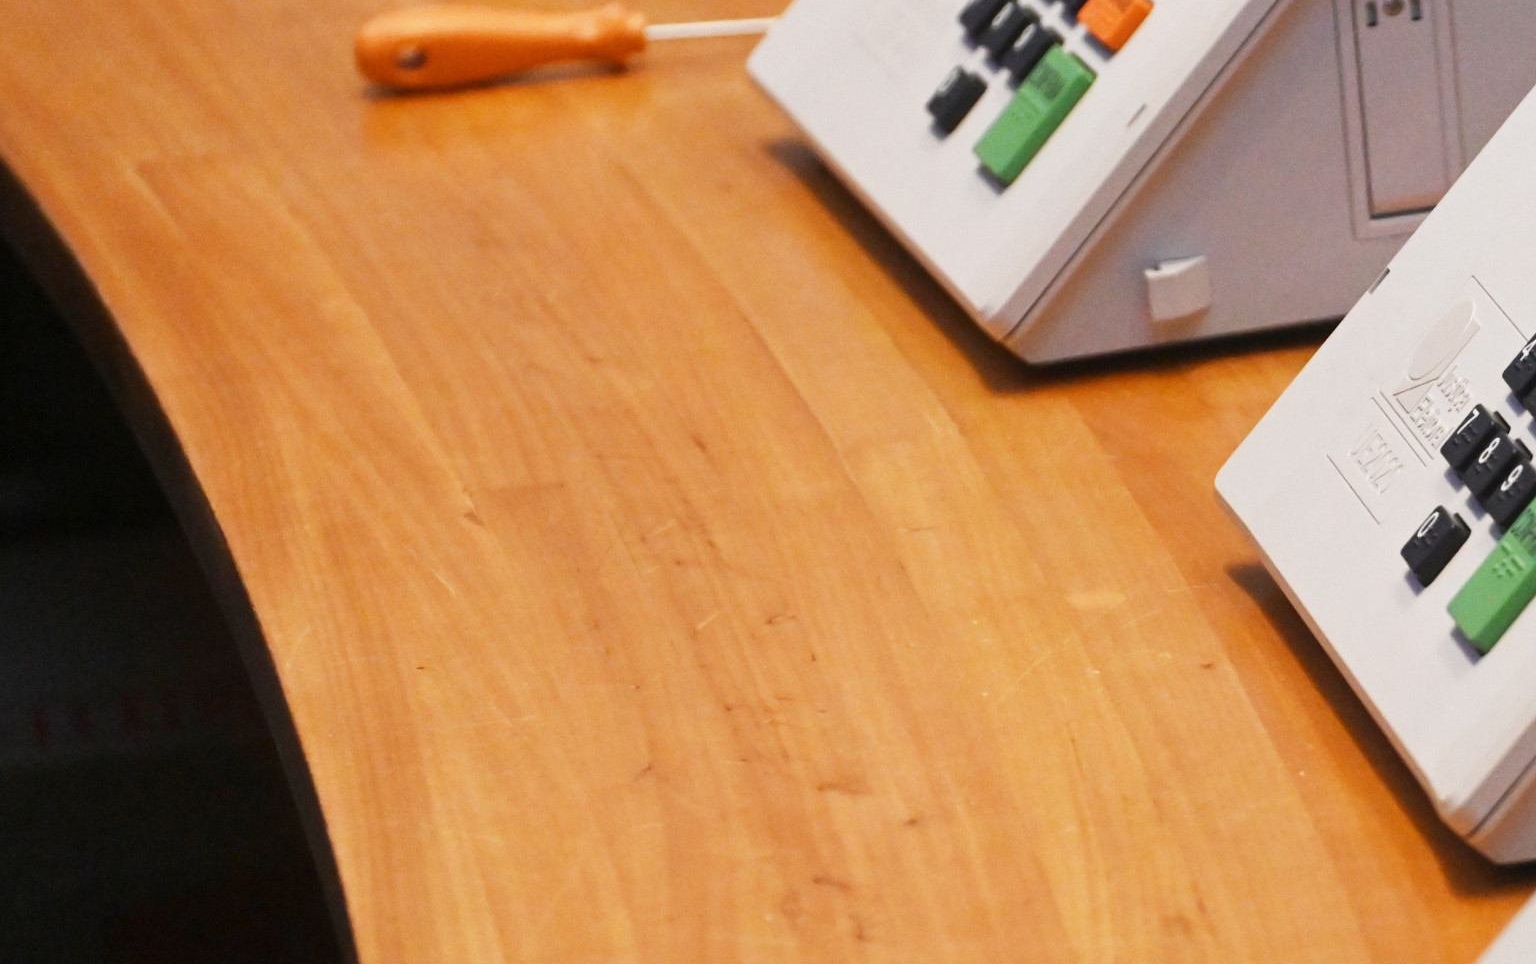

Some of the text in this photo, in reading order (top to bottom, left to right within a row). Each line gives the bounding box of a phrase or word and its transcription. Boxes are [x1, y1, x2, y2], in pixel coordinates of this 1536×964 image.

[1456, 408, 1480, 435] 7
[1478, 437, 1501, 464] 8
[1500, 464, 1524, 492] 9
[1417, 511, 1440, 538] 0
